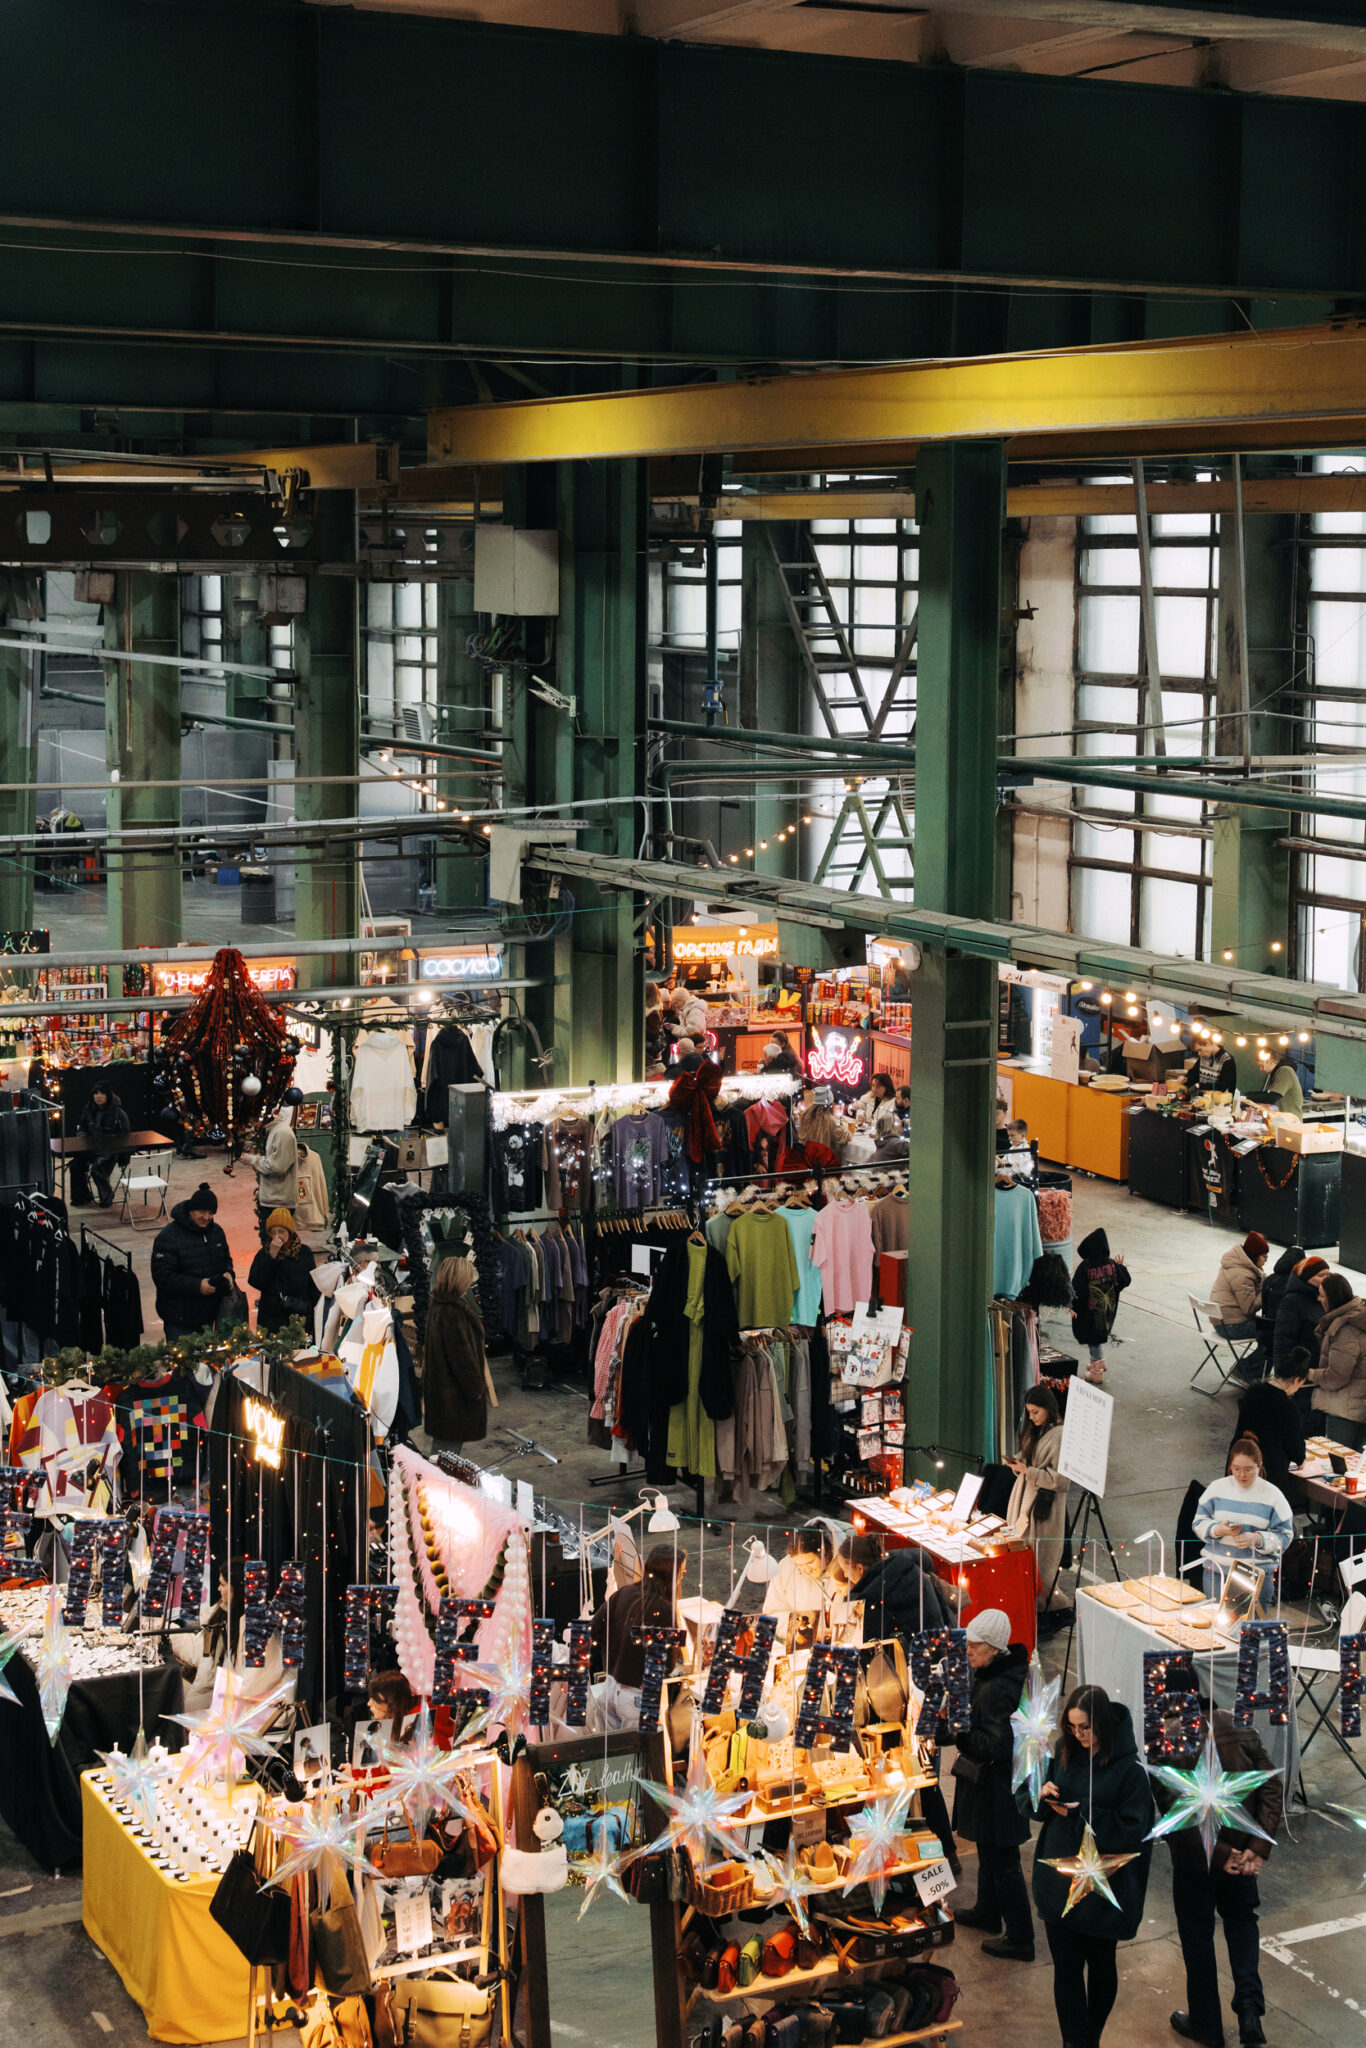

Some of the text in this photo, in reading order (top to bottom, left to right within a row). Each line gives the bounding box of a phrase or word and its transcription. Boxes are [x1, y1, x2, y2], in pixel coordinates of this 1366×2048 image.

[672, 937, 778, 958] ОРСКИЕ ГАДЫ
[921, 1864, 944, 1883] SALE
[927, 1879, 950, 1897] -50%
